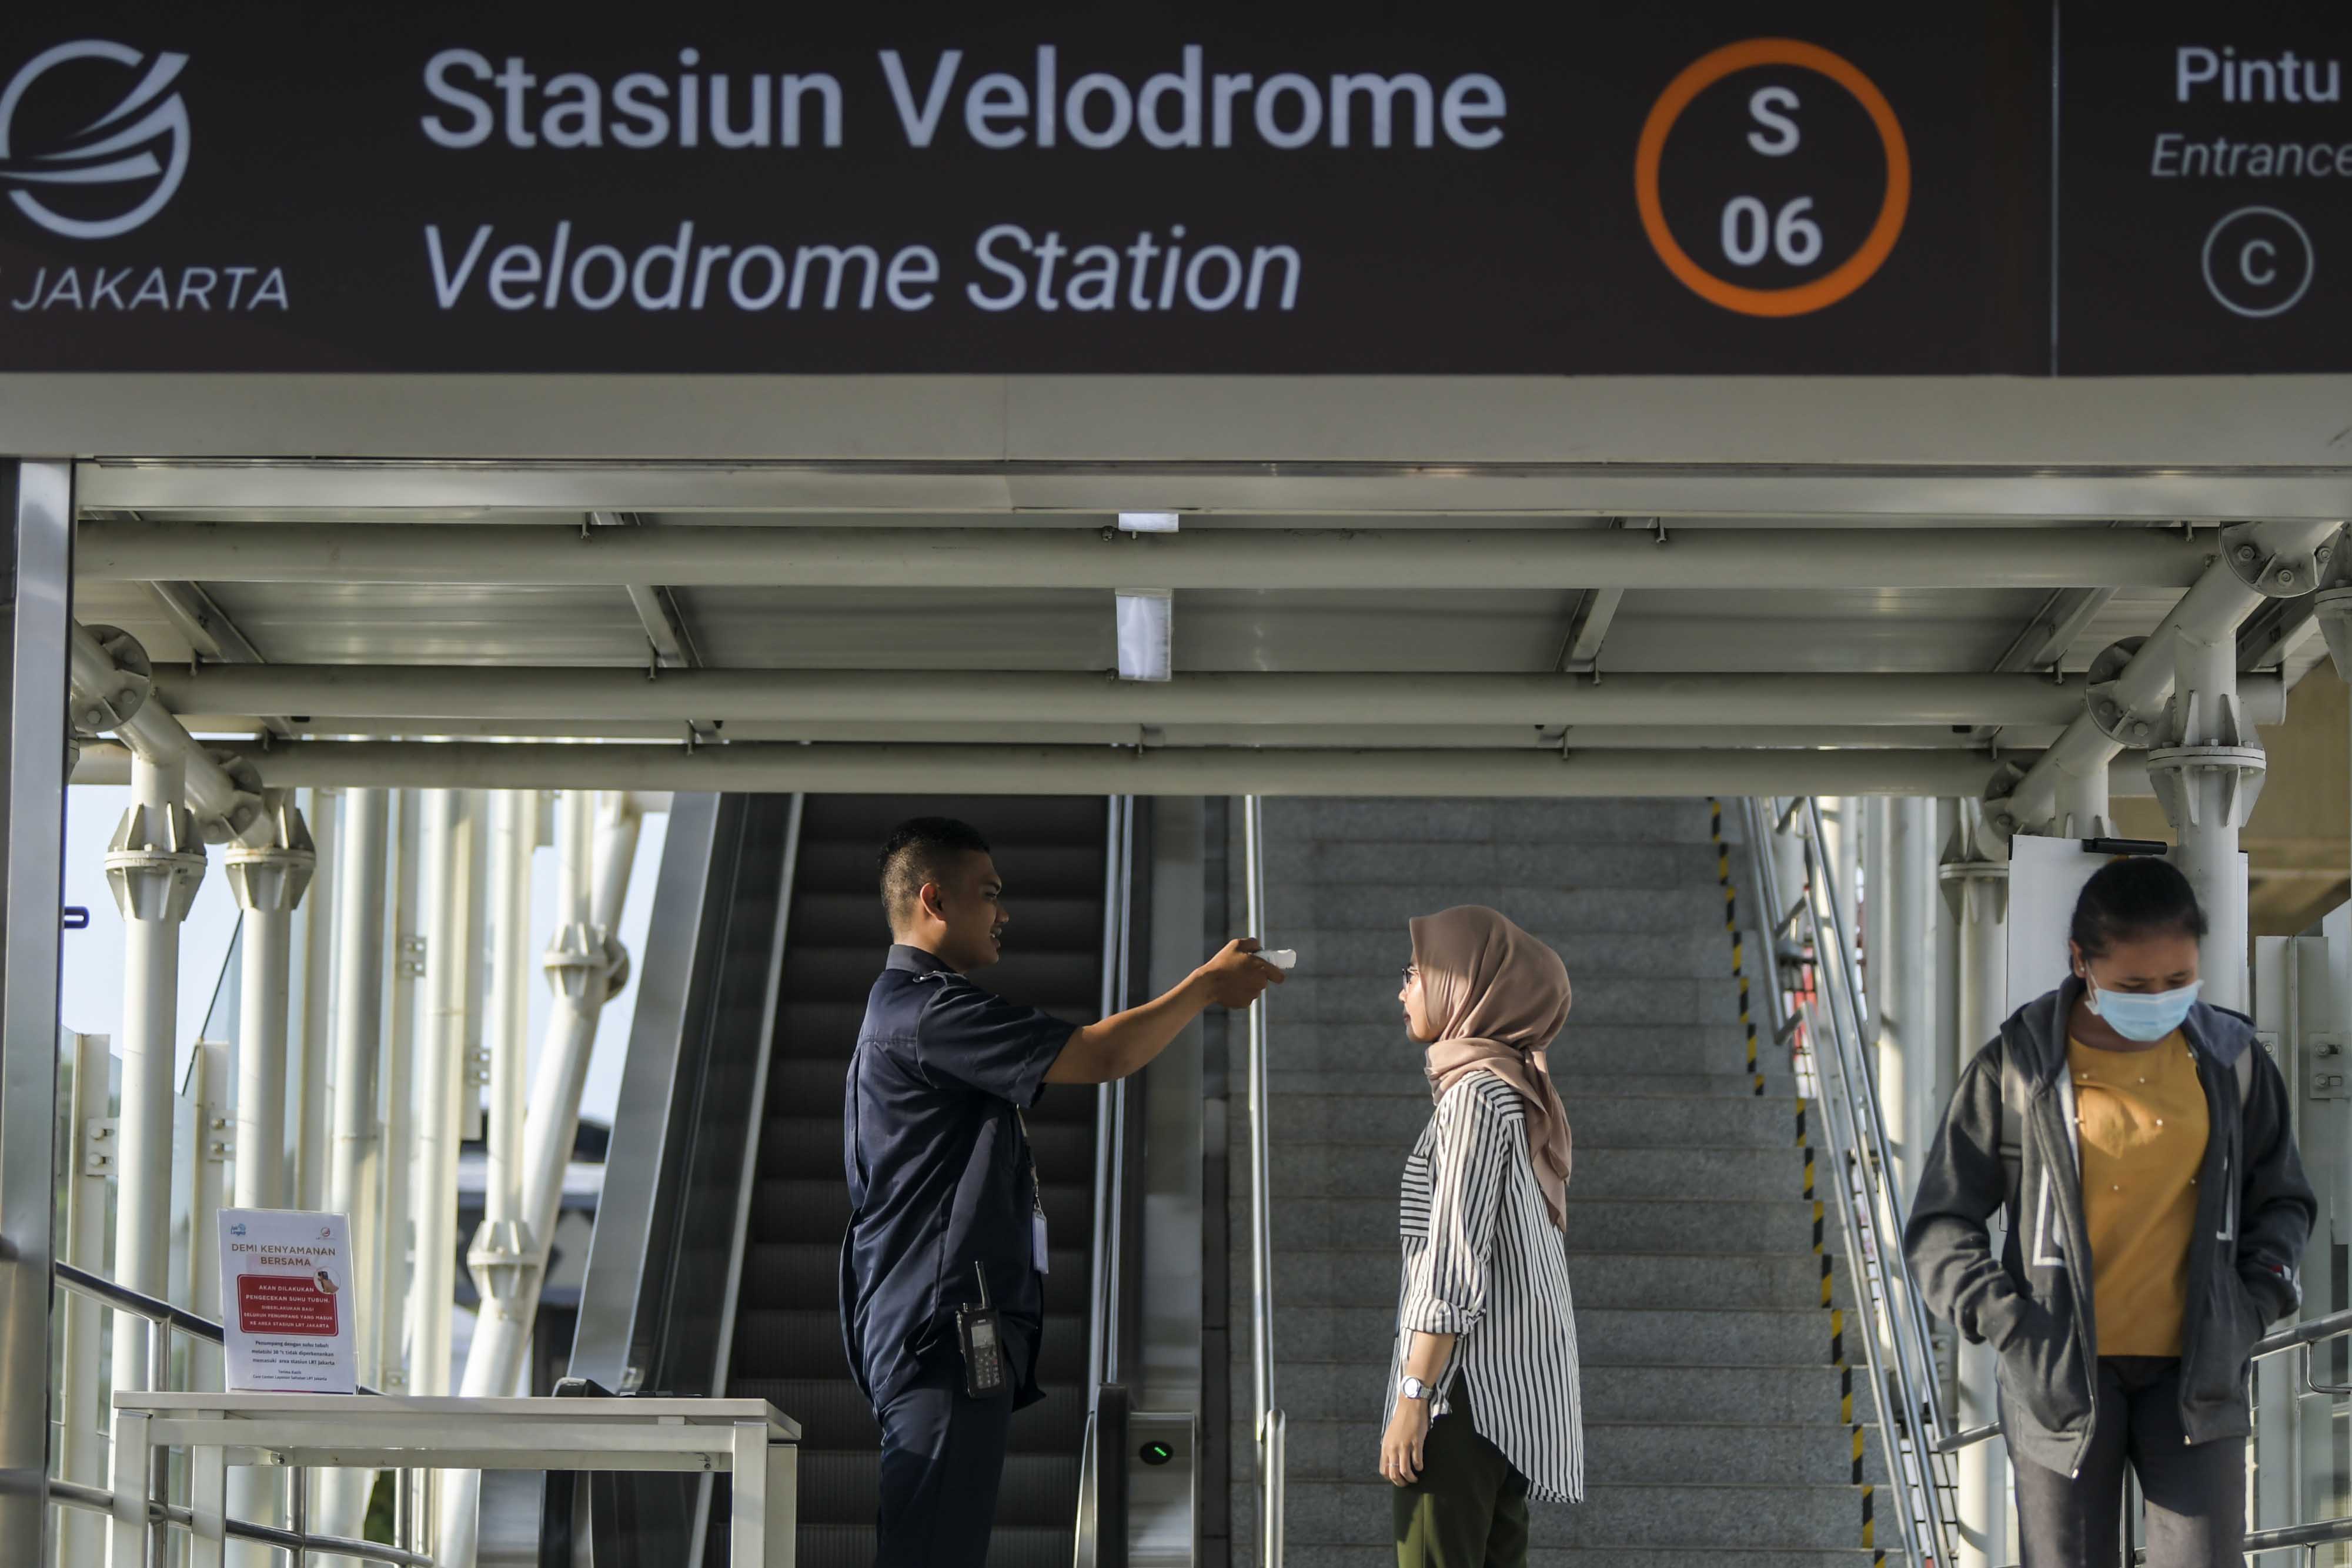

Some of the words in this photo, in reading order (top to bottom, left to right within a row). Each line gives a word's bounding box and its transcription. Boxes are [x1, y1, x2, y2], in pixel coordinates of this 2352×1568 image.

[421, 48, 842, 148] Stasiun
[880, 45, 1506, 149] Velodrome
[2177, 46, 2340, 102] Pintu
[1748, 86, 1799, 156] S
[2151, 133, 2352, 176] Entrance
[1721, 196, 1823, 267] 06
[425, 220, 940, 311] Velodrome
[967, 224, 1301, 311] Station
[2240, 239, 2276, 285] C
[11, 266, 289, 311] JAKARTA
[232, 1243, 257, 1252] DEMI
[260, 1245, 335, 1256] KENYAMANAN
[260, 1256, 310, 1266] BERSAMA
